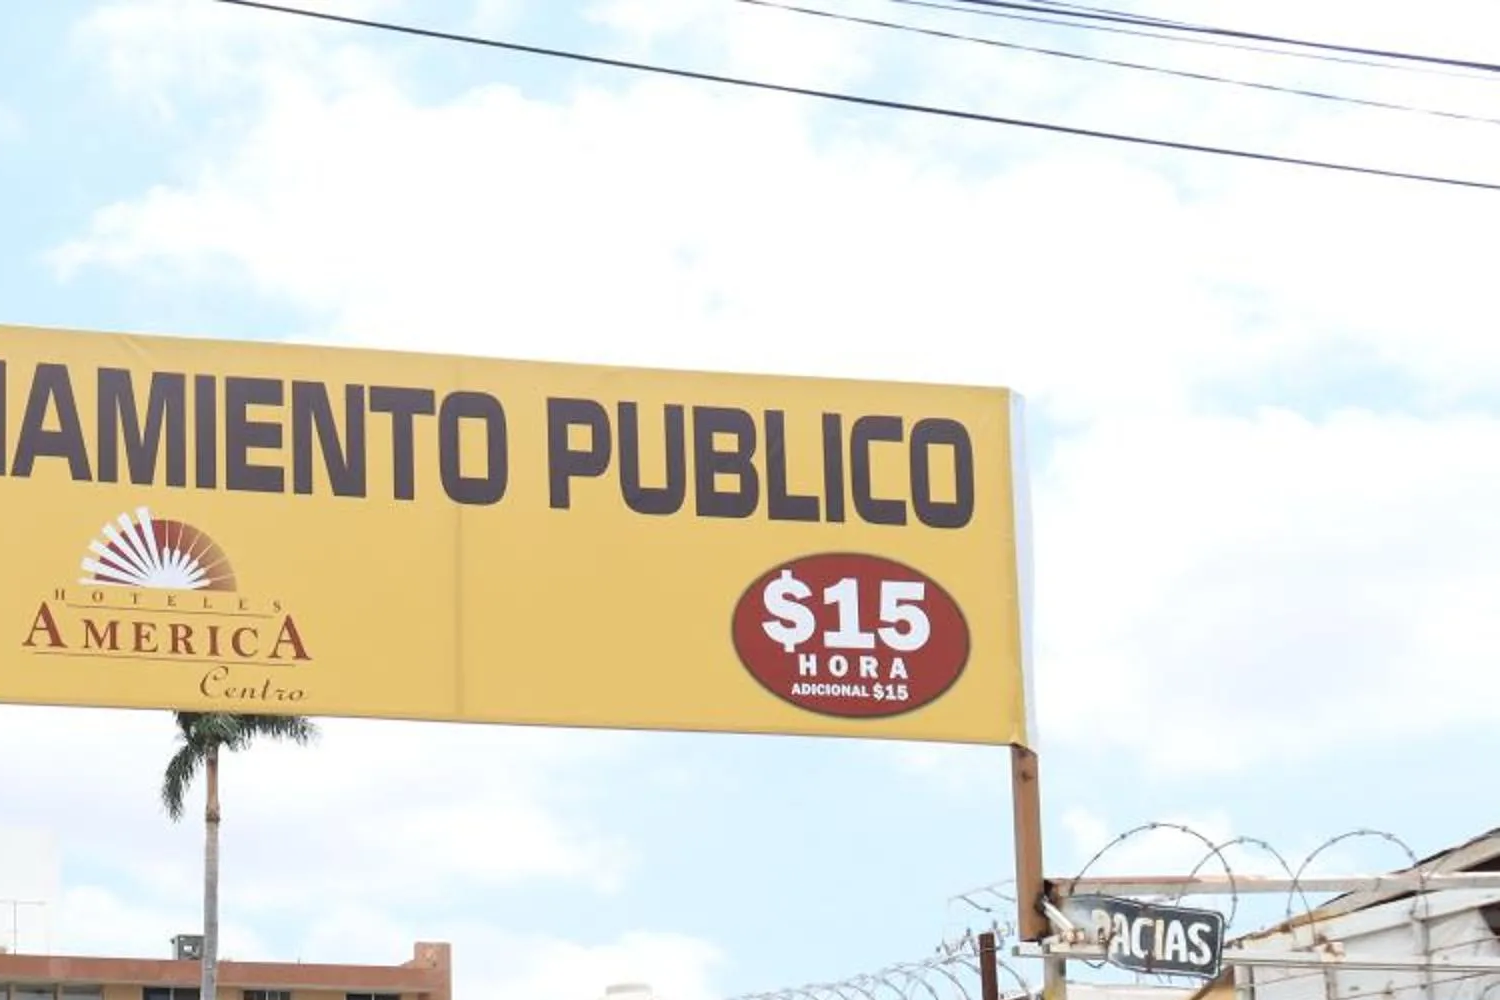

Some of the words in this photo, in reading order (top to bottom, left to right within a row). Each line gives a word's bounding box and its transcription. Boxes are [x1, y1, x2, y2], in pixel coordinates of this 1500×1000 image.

[547, 397, 975, 529] PUBLICO
[54, 588, 282, 614] HOTELES
[761, 569, 931, 653] $15
[22, 601, 312, 660] AMERICA
[199, 666, 306, 701] Centro
[799, 653, 908, 680] HORA
[792, 683, 869, 698] ADICIONAL
[873, 683, 909, 701] $15
[1091, 909, 1213, 966] RACIAS
